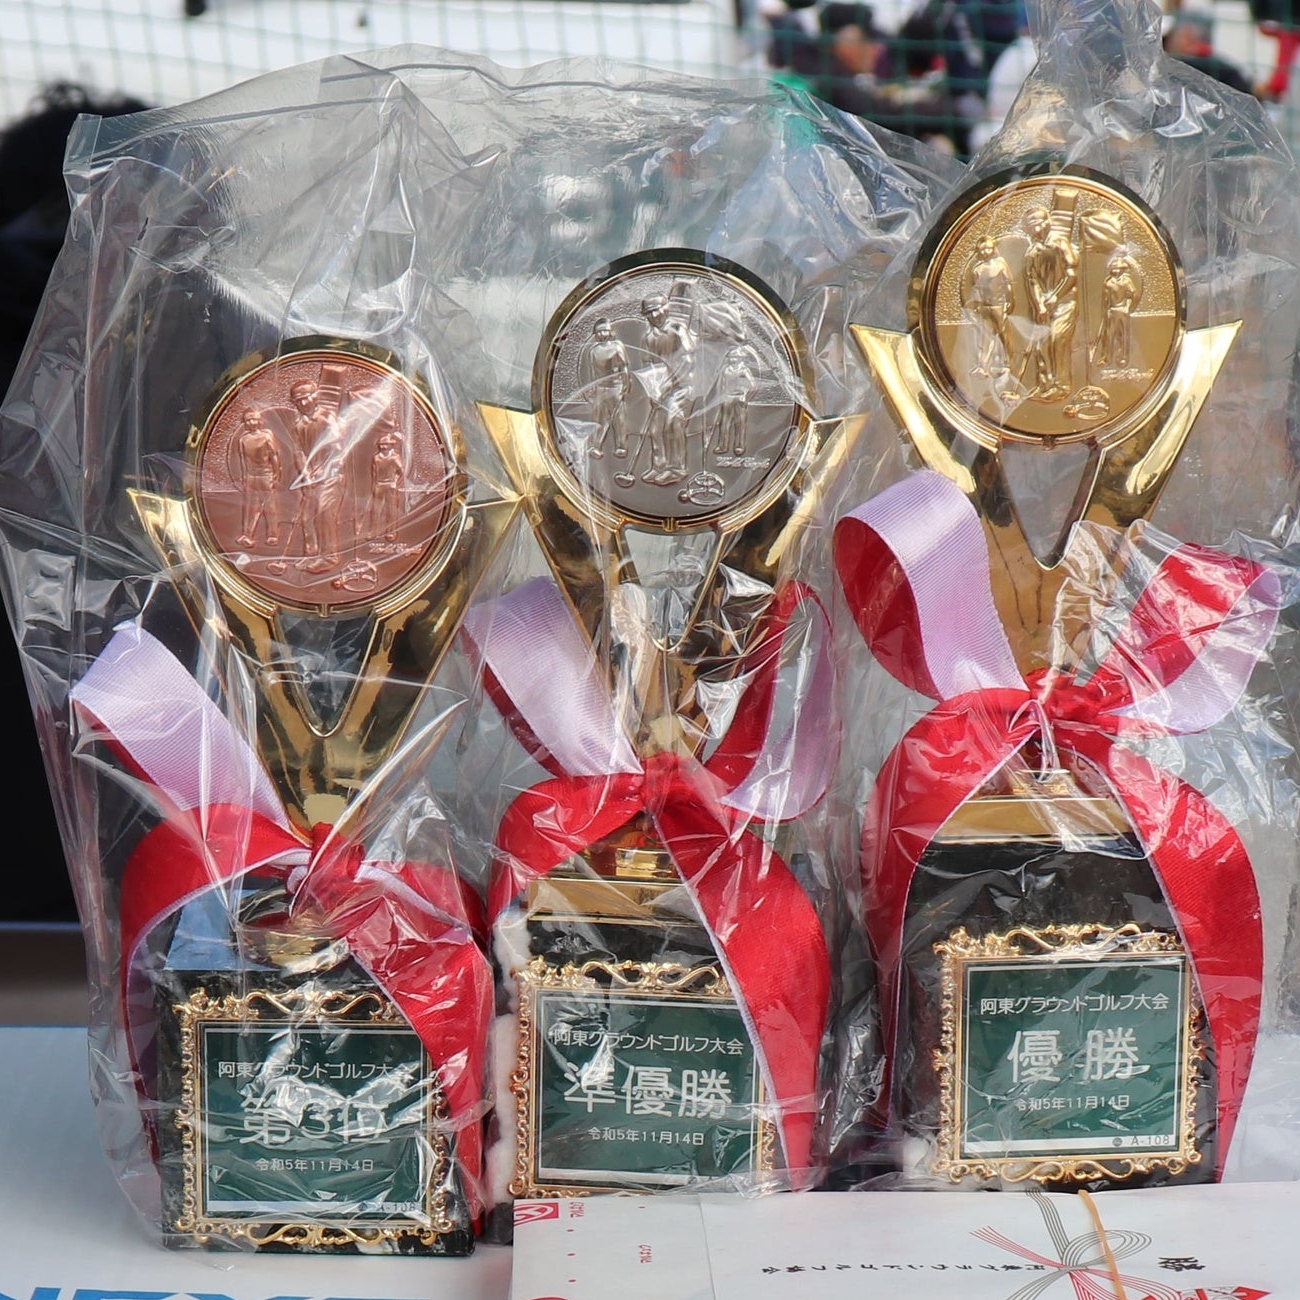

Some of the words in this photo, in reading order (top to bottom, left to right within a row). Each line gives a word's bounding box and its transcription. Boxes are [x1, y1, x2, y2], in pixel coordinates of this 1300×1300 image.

[980, 992, 1170, 1016] 阿東グラウンドゴルフ大会
[553, 1027, 745, 1057] 阿東グラウンドゴルフ大会
[1006, 1026, 1140, 1084] 優勝
[563, 1061, 733, 1120] 準優勝
[1017, 1094, 1131, 1112] 令和5年11月14日
[238, 1095, 391, 1146] 第3位
[587, 1126, 706, 1147] 令和5年11月14日
[1130, 1134, 1171, 1146] A-108
[254, 1157, 375, 1173] 令和5年11月14日
